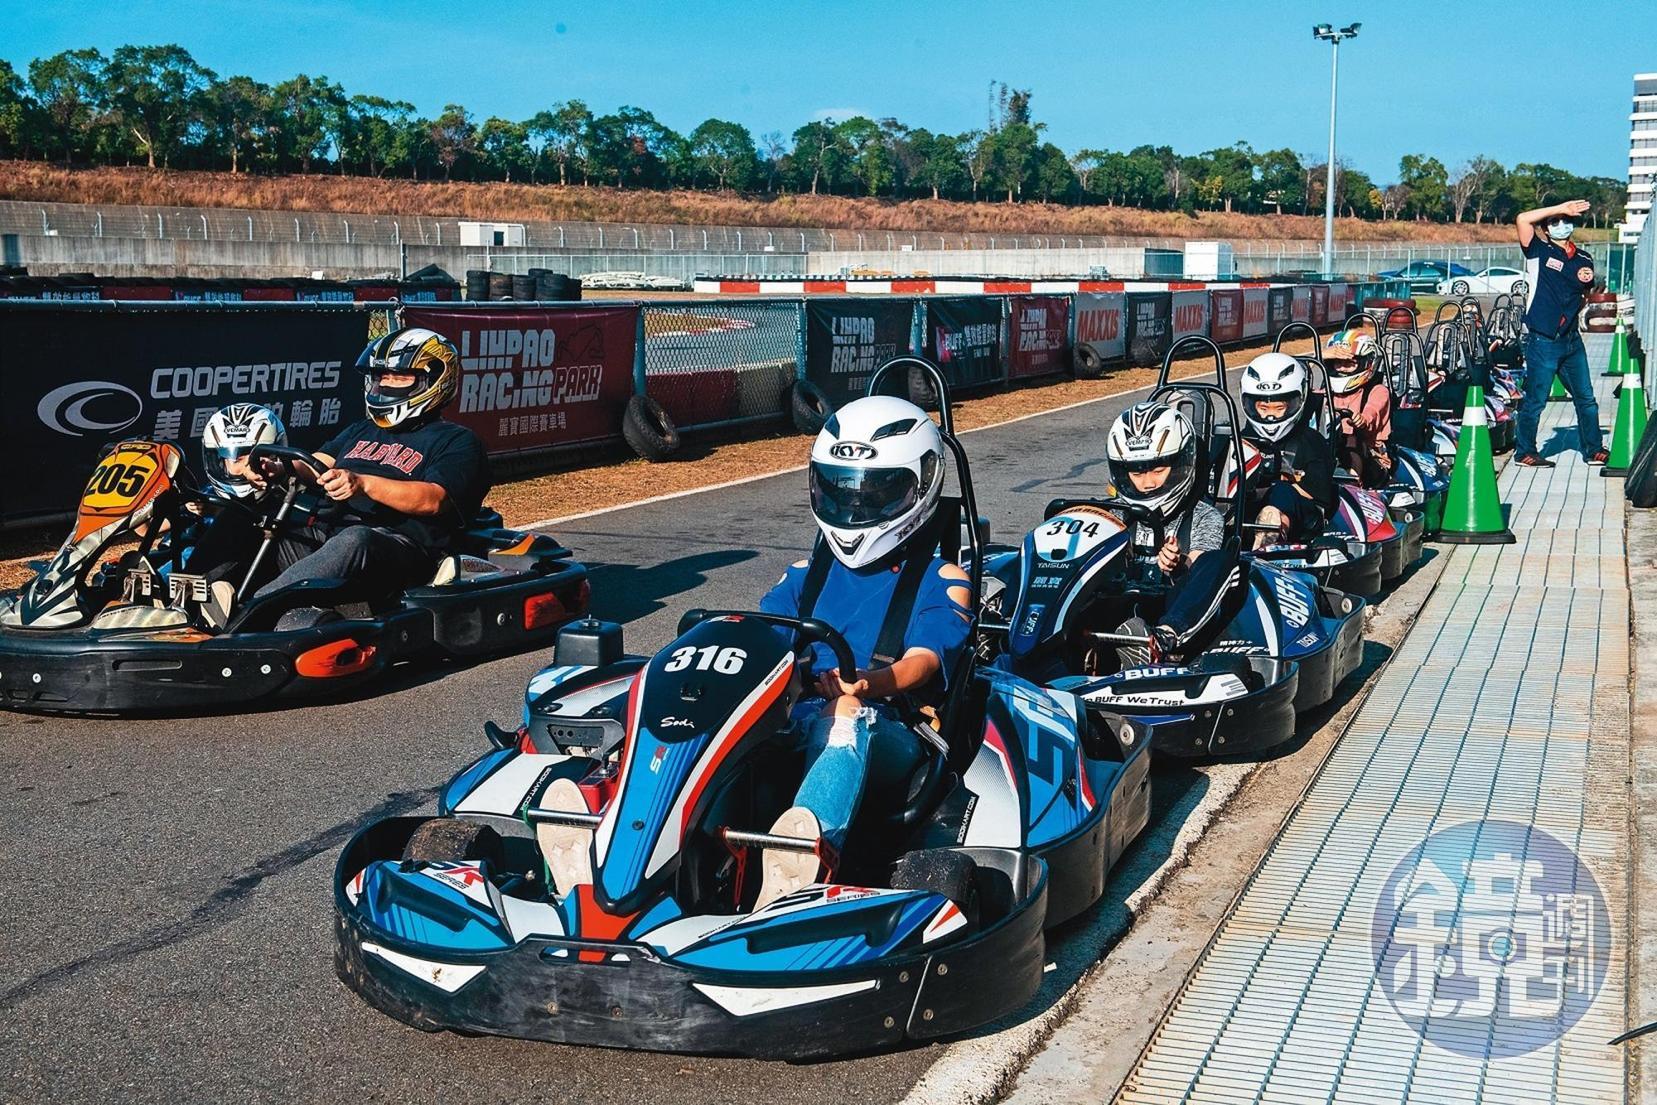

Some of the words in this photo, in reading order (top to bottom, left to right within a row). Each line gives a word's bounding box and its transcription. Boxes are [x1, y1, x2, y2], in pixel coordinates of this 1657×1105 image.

[1077, 308, 1119, 342] MAXXIS
[1174, 304, 1204, 333] MAXXIS
[945, 332, 962, 350] BUFF
[459, 370, 555, 413] RACING
[553, 364, 602, 404] PARK
[344, 440, 423, 474] HARVARD
[834, 444, 871, 459] KYT
[86, 463, 150, 498] 205
[1047, 519, 1101, 538] 304
[1274, 576, 1309, 627] BUFF
[664, 645, 748, 675] 316
[1125, 667, 1188, 680] BUFF
[1127, 696, 1147, 704] We
[1147, 697, 1185, 706] Trust
[660, 716, 695, 729] Sodi
